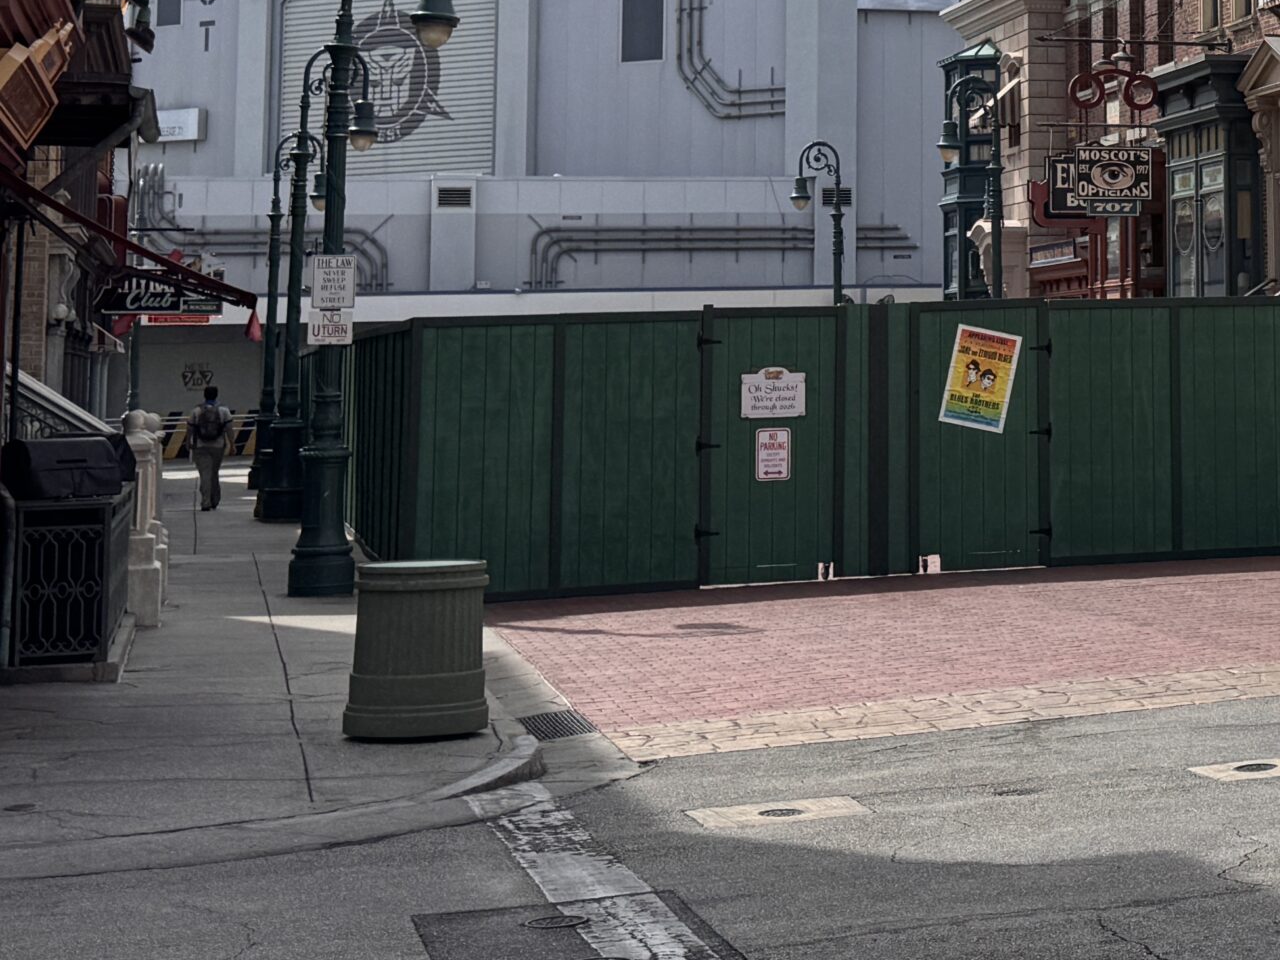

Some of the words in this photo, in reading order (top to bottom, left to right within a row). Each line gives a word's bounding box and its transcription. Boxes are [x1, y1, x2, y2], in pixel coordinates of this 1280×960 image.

[1079, 150, 1149, 160] MOSCOT'S
[1136, 165, 1148, 175] 1917
[1078, 181, 1149, 197] OPTICIANS
[1094, 203, 1133, 212] 707
[317, 259, 332, 268] THE
[336, 259, 352, 268] LAW
[126, 290, 177, 309] Club
[323, 313, 341, 323] NO
[313, 324, 320, 337] U
[322, 326, 347, 336] TURN
[748, 384, 762, 394] Oh
[765, 383, 798, 394] Shucks!
[751, 403, 777, 412] through
[769, 432, 778, 441] NO
[760, 442, 786, 451] PARKING
